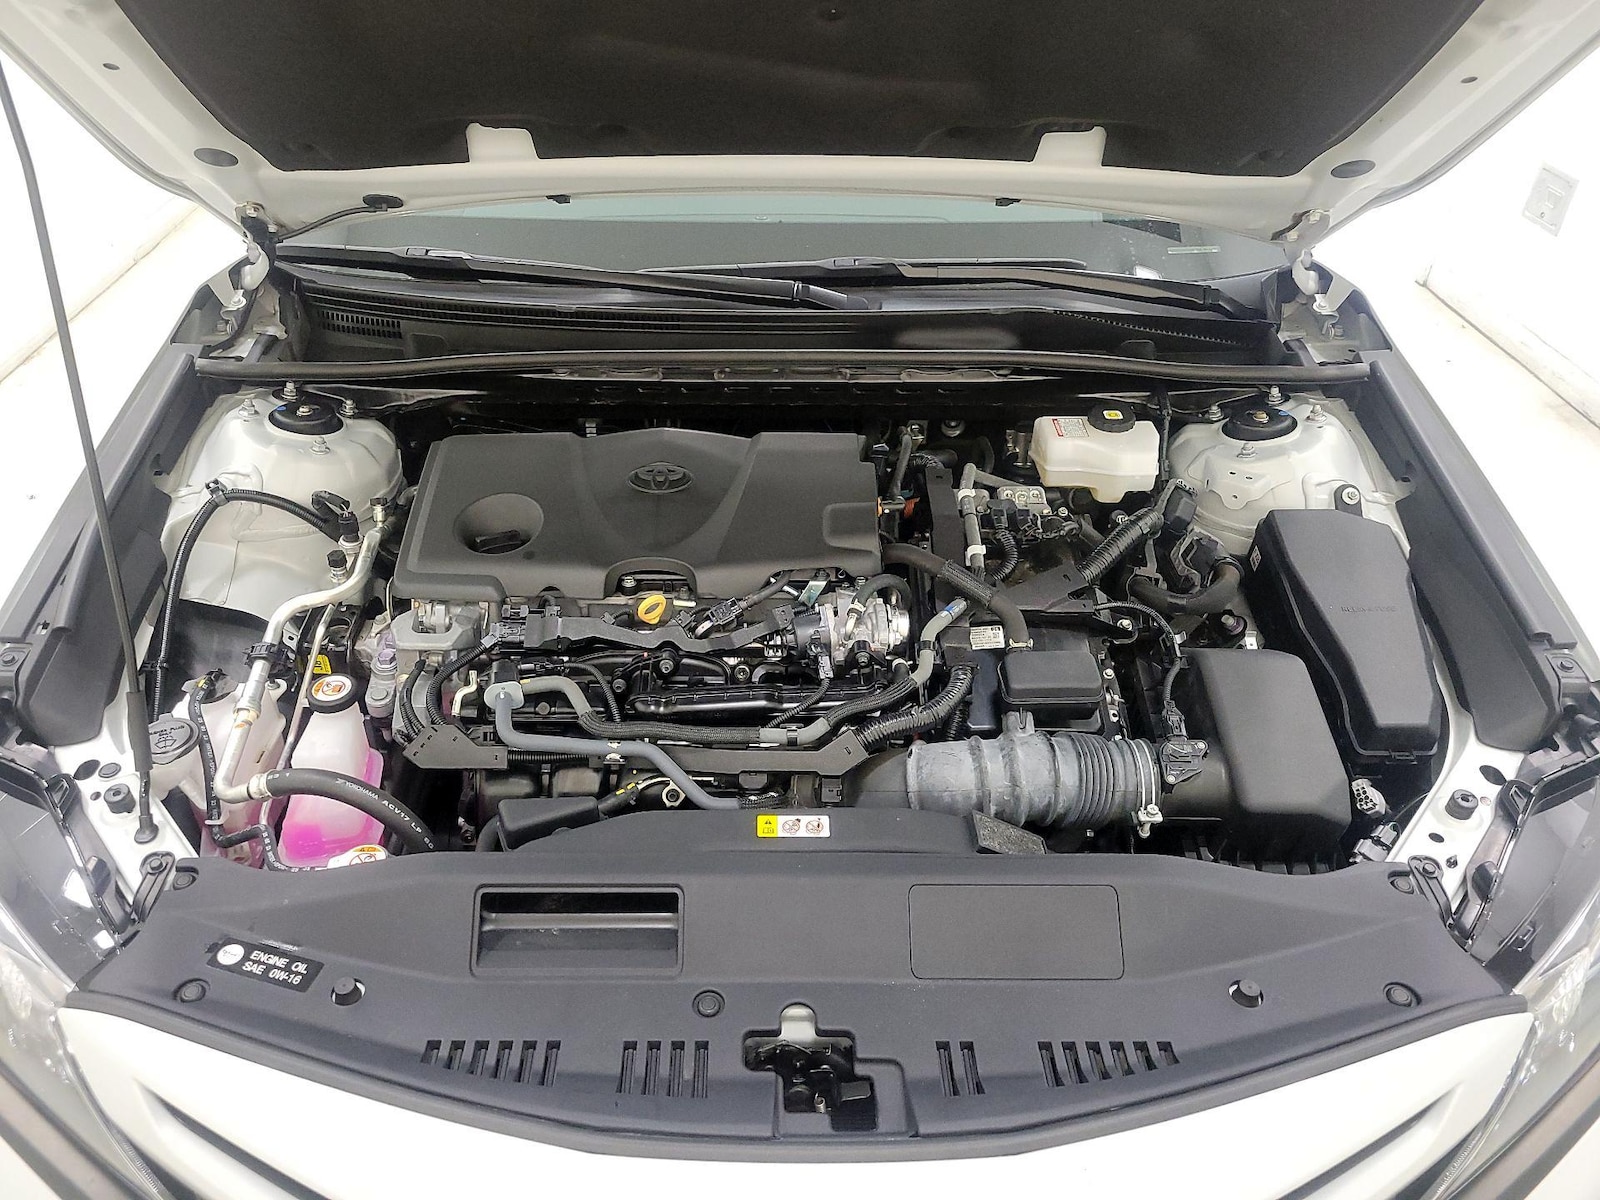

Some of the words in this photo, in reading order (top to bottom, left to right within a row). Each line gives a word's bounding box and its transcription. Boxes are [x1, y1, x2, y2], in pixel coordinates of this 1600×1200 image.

[381, 800, 410, 821] ACV17
[410, 822, 422, 833] LP
[242, 961, 266, 975] SAE
[268, 969, 302, 985] 0W-16
[249, 950, 289, 968] ENGINE
[291, 962, 308, 975] OIL
